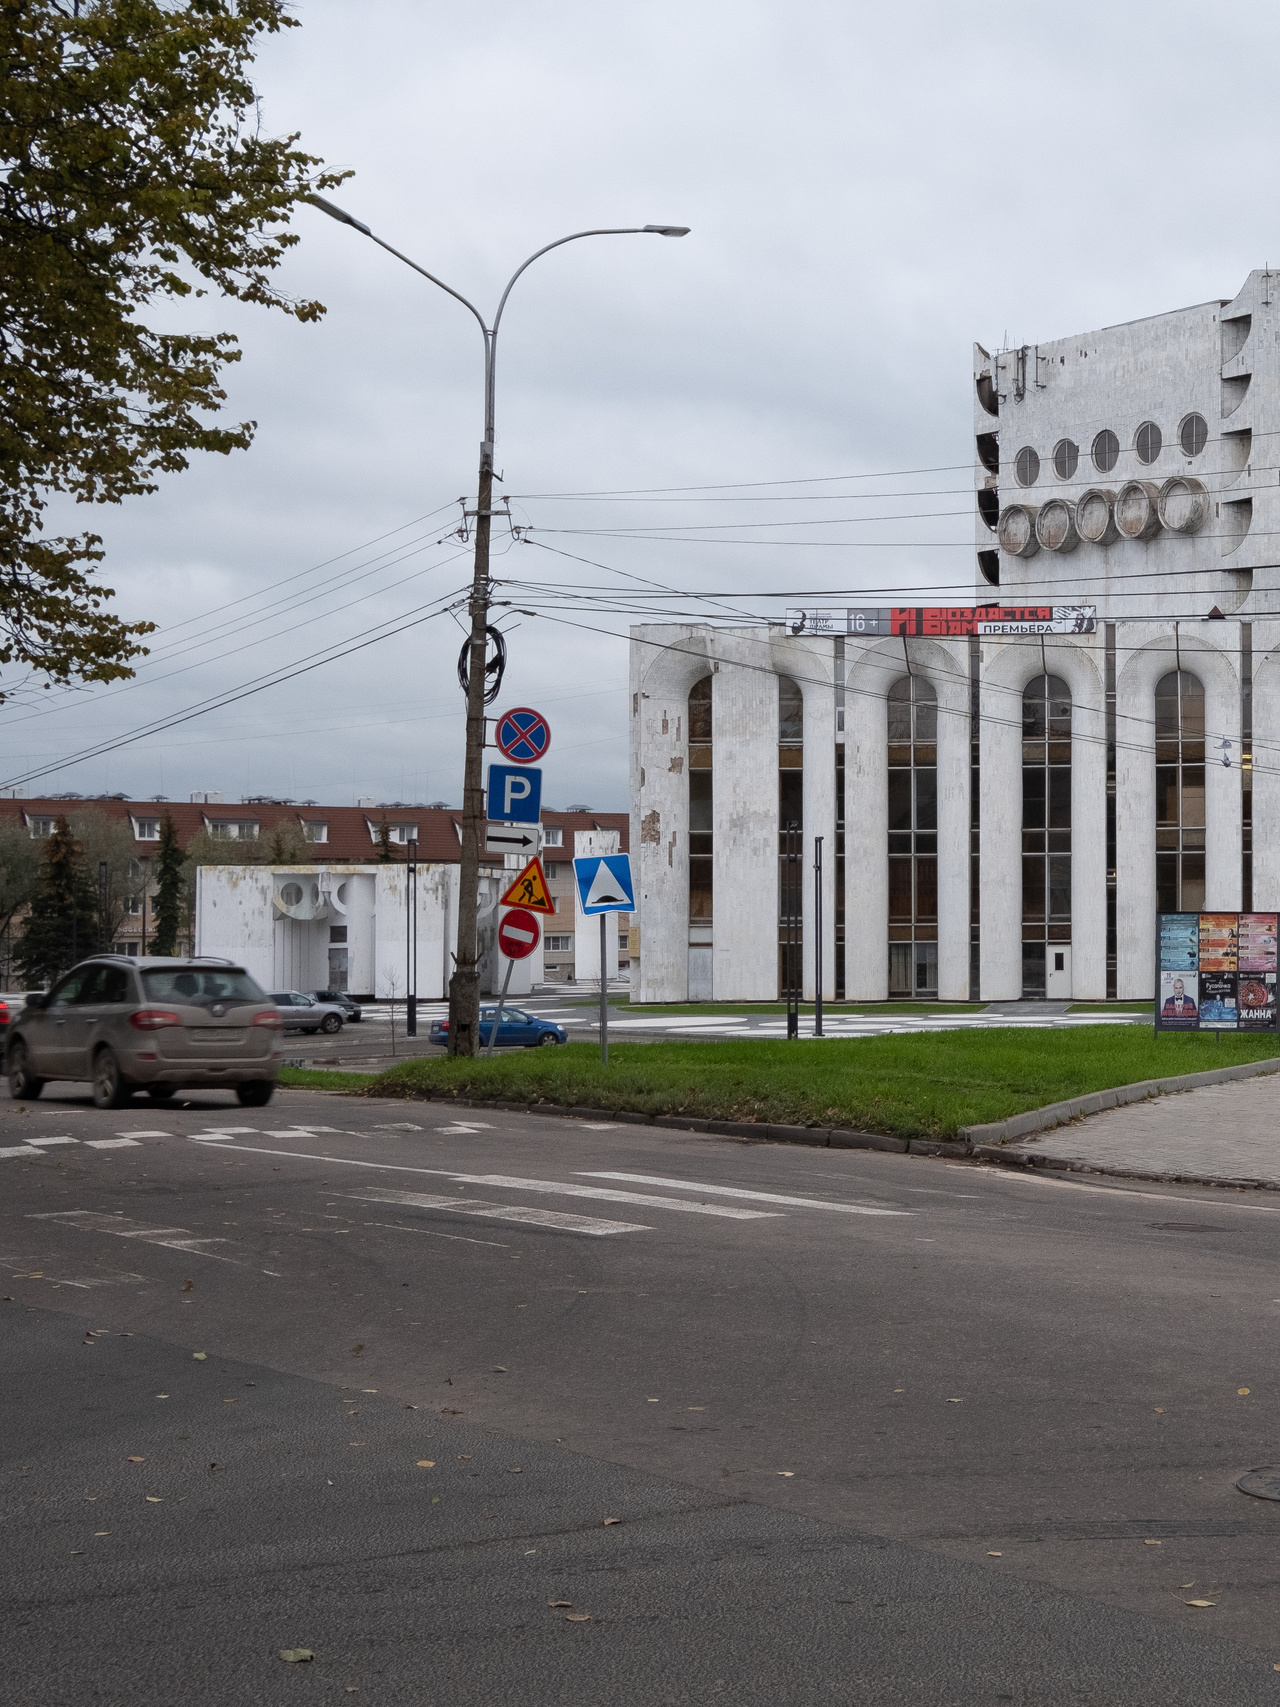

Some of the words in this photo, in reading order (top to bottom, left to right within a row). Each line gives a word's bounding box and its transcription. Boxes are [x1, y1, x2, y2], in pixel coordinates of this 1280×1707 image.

[891, 608, 917, 635] И
[984, 624, 1053, 634] ПРЕМЬЕРА
[504, 775, 532, 814] P
[1240, 1009, 1272, 1019] ЖАННА
